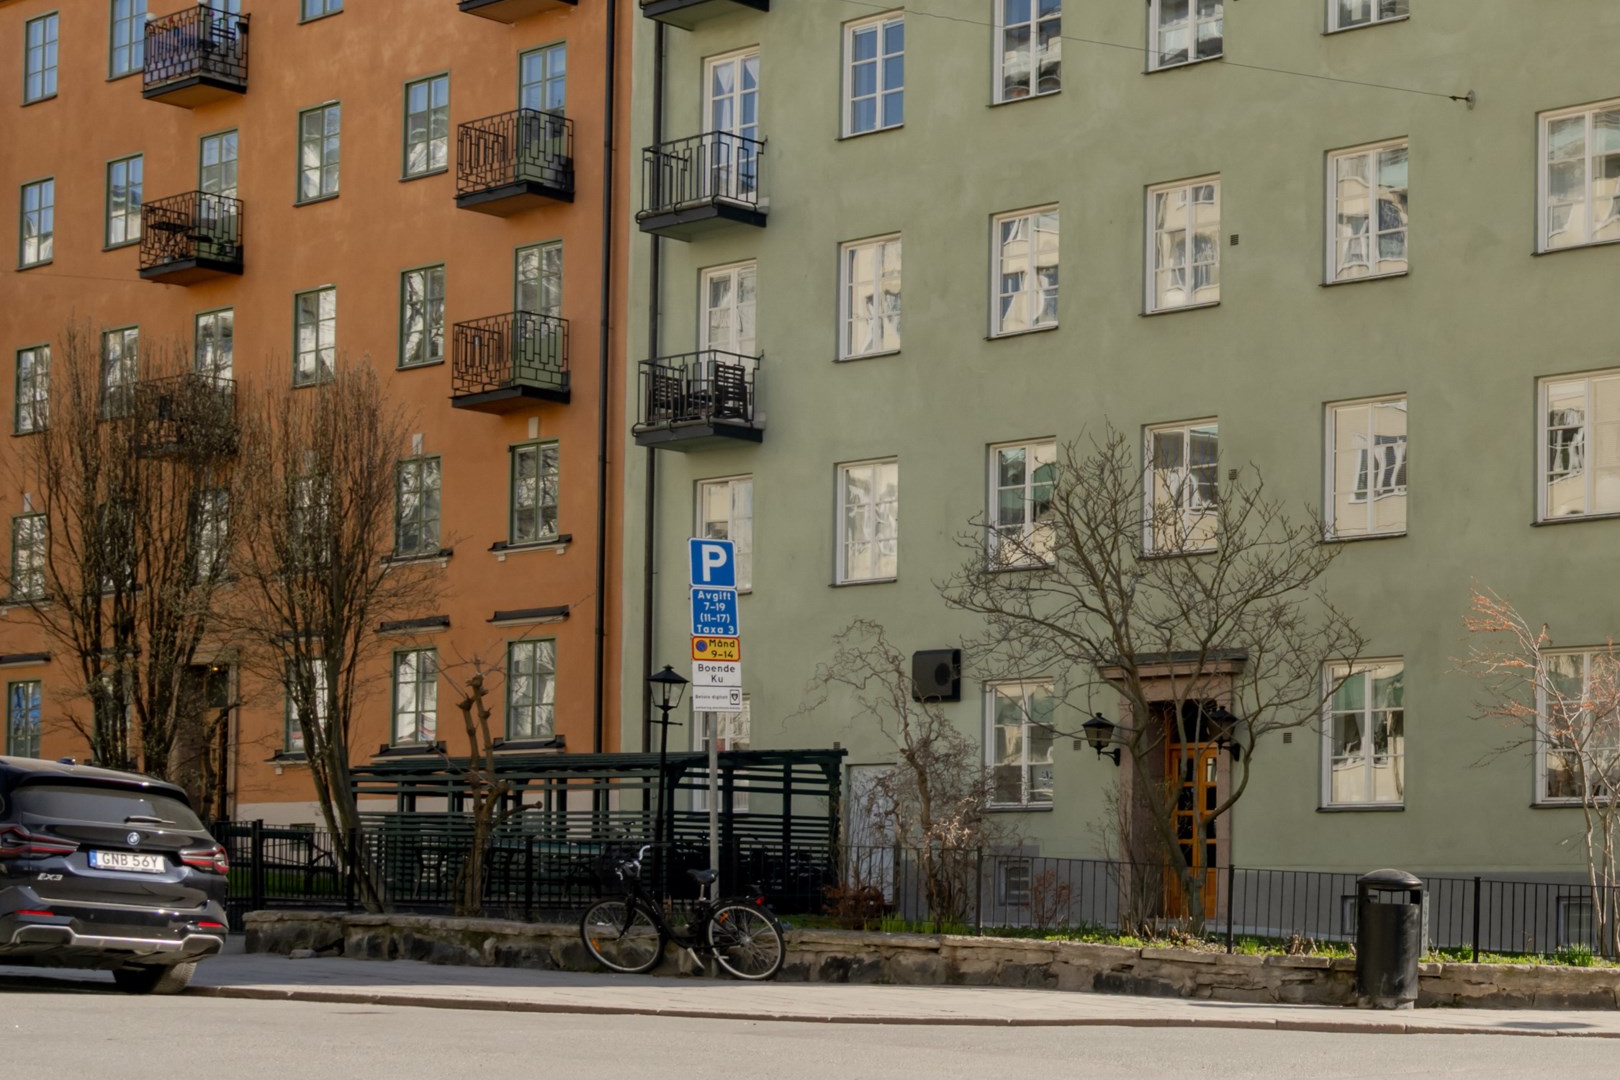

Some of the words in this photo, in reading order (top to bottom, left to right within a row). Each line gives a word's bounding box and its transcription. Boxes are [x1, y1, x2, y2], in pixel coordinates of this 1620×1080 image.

[701, 544, 727, 582] P
[698, 590, 731, 602] Avgift
[697, 624, 724, 634] Taxa
[728, 625, 734, 634] 3
[709, 639, 736, 648] Månd
[698, 663, 736, 673] Boende
[711, 674, 724, 683] Ku
[102, 852, 128, 866] GNB
[132, 854, 158, 868] 56Y
